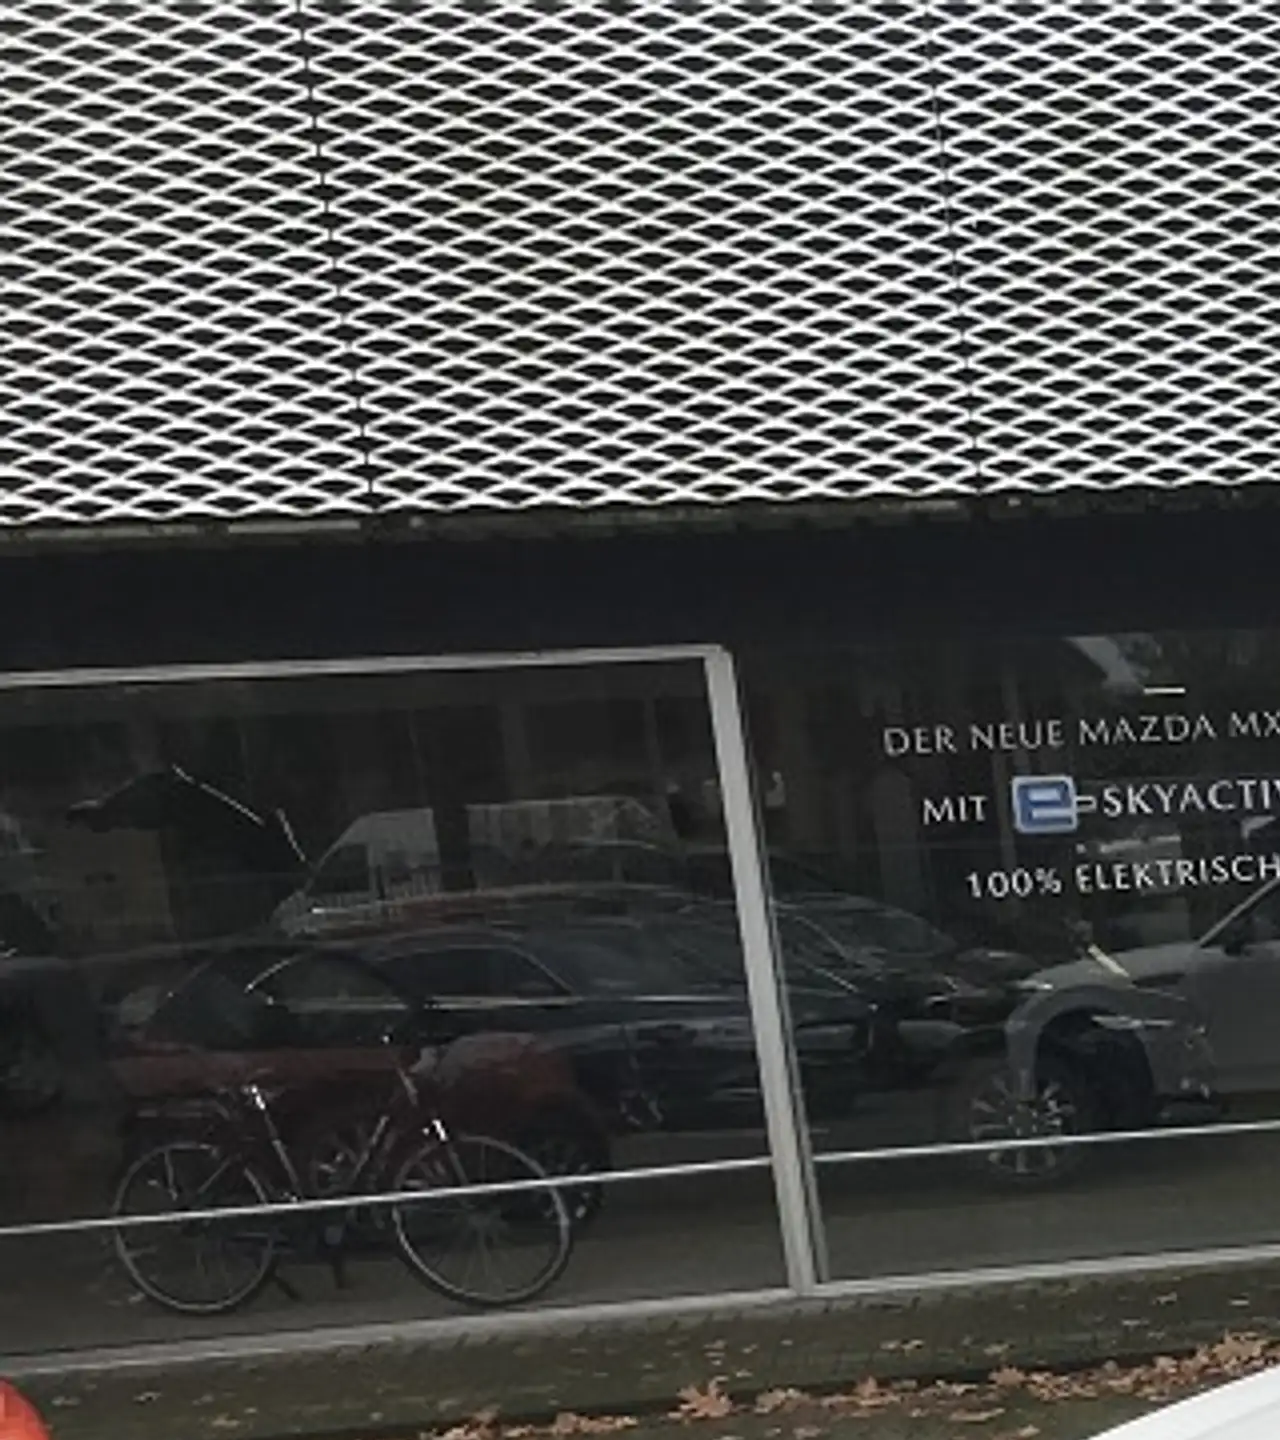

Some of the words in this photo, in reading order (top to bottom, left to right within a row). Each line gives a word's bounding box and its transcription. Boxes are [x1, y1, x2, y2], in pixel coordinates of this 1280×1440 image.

[883, 725, 957, 757] DER
[969, 720, 1064, 752] NEUE
[1078, 714, 1217, 746] MAZDA
[922, 795, 988, 826] MIT
[965, 867, 1062, 898] 100%
